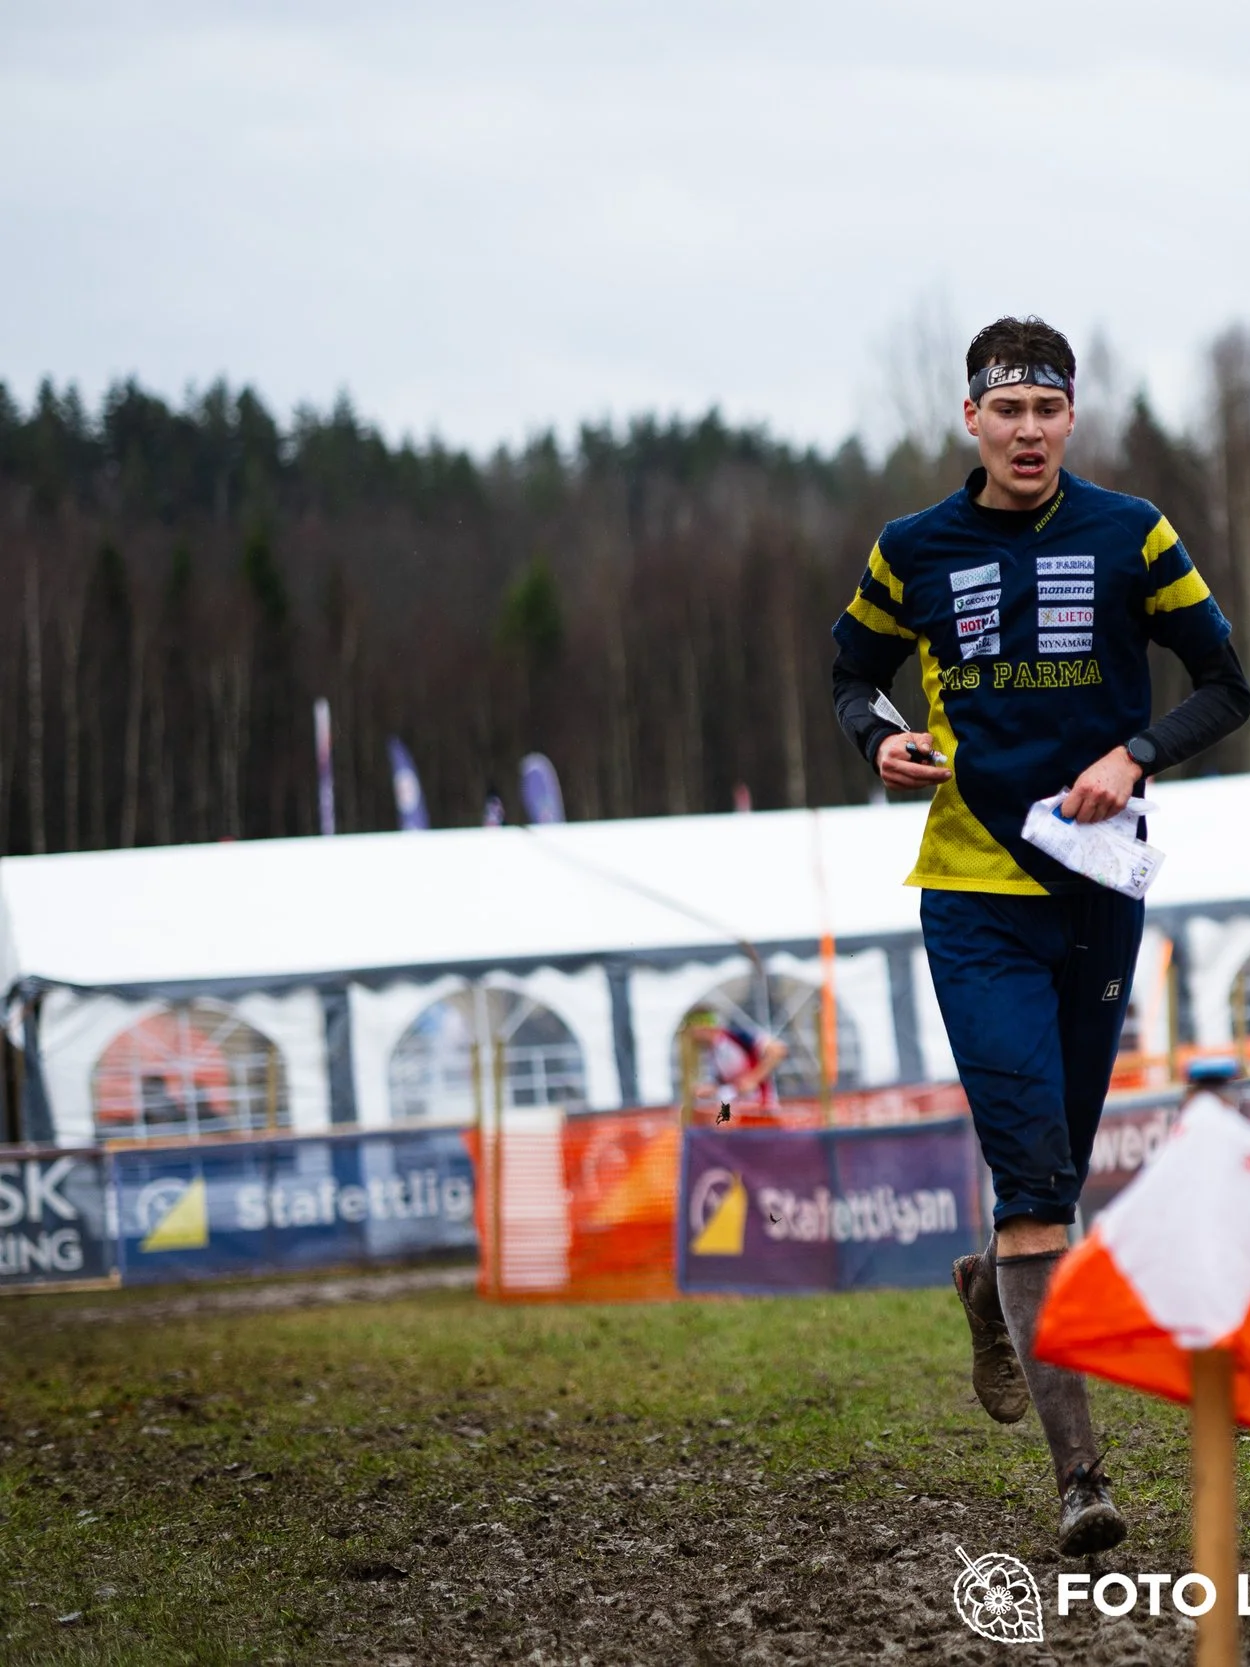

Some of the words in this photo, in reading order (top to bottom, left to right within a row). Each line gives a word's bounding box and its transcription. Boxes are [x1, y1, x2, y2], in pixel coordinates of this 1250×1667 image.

[1034, 490, 1065, 533] noname
[1056, 560, 1094, 570] PARMA
[1040, 586, 1094, 595] noname
[1058, 611, 1093, 623] LIETO
[942, 665, 981, 691] MS
[993, 660, 1103, 689] PARMA
[758, 1184, 957, 1246] Stafettligan
[0, 1228, 84, 1275] ING
